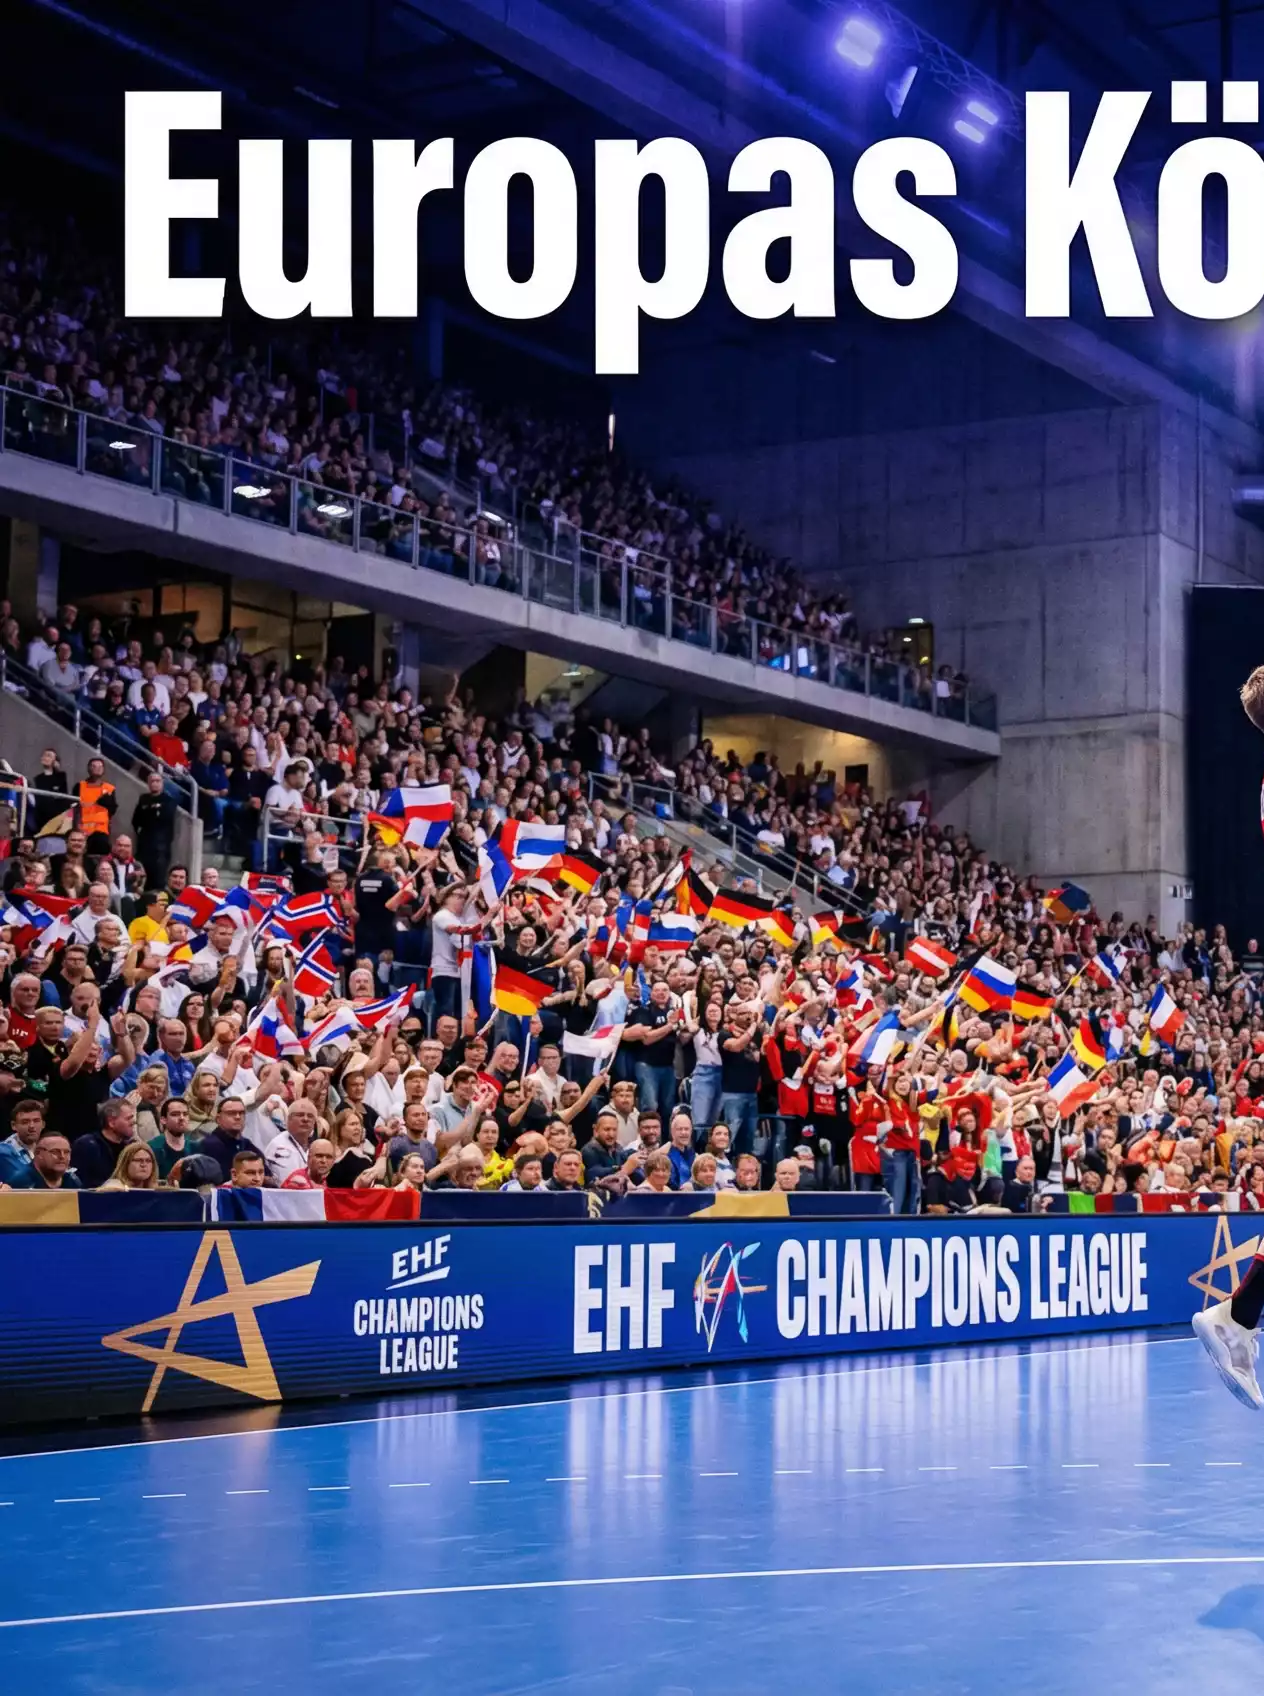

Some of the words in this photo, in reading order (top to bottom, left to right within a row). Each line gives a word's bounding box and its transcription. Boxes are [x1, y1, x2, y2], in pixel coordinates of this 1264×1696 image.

[392, 1234, 451, 1281] EHF
[353, 1294, 484, 1337] CHAMPIONS
[573, 1242, 676, 1354] EHF
[776, 1234, 1021, 1340] CHAMPIONS
[1029, 1232, 1149, 1320] LEAGUE
[379, 1333, 458, 1374] LEAGUE
